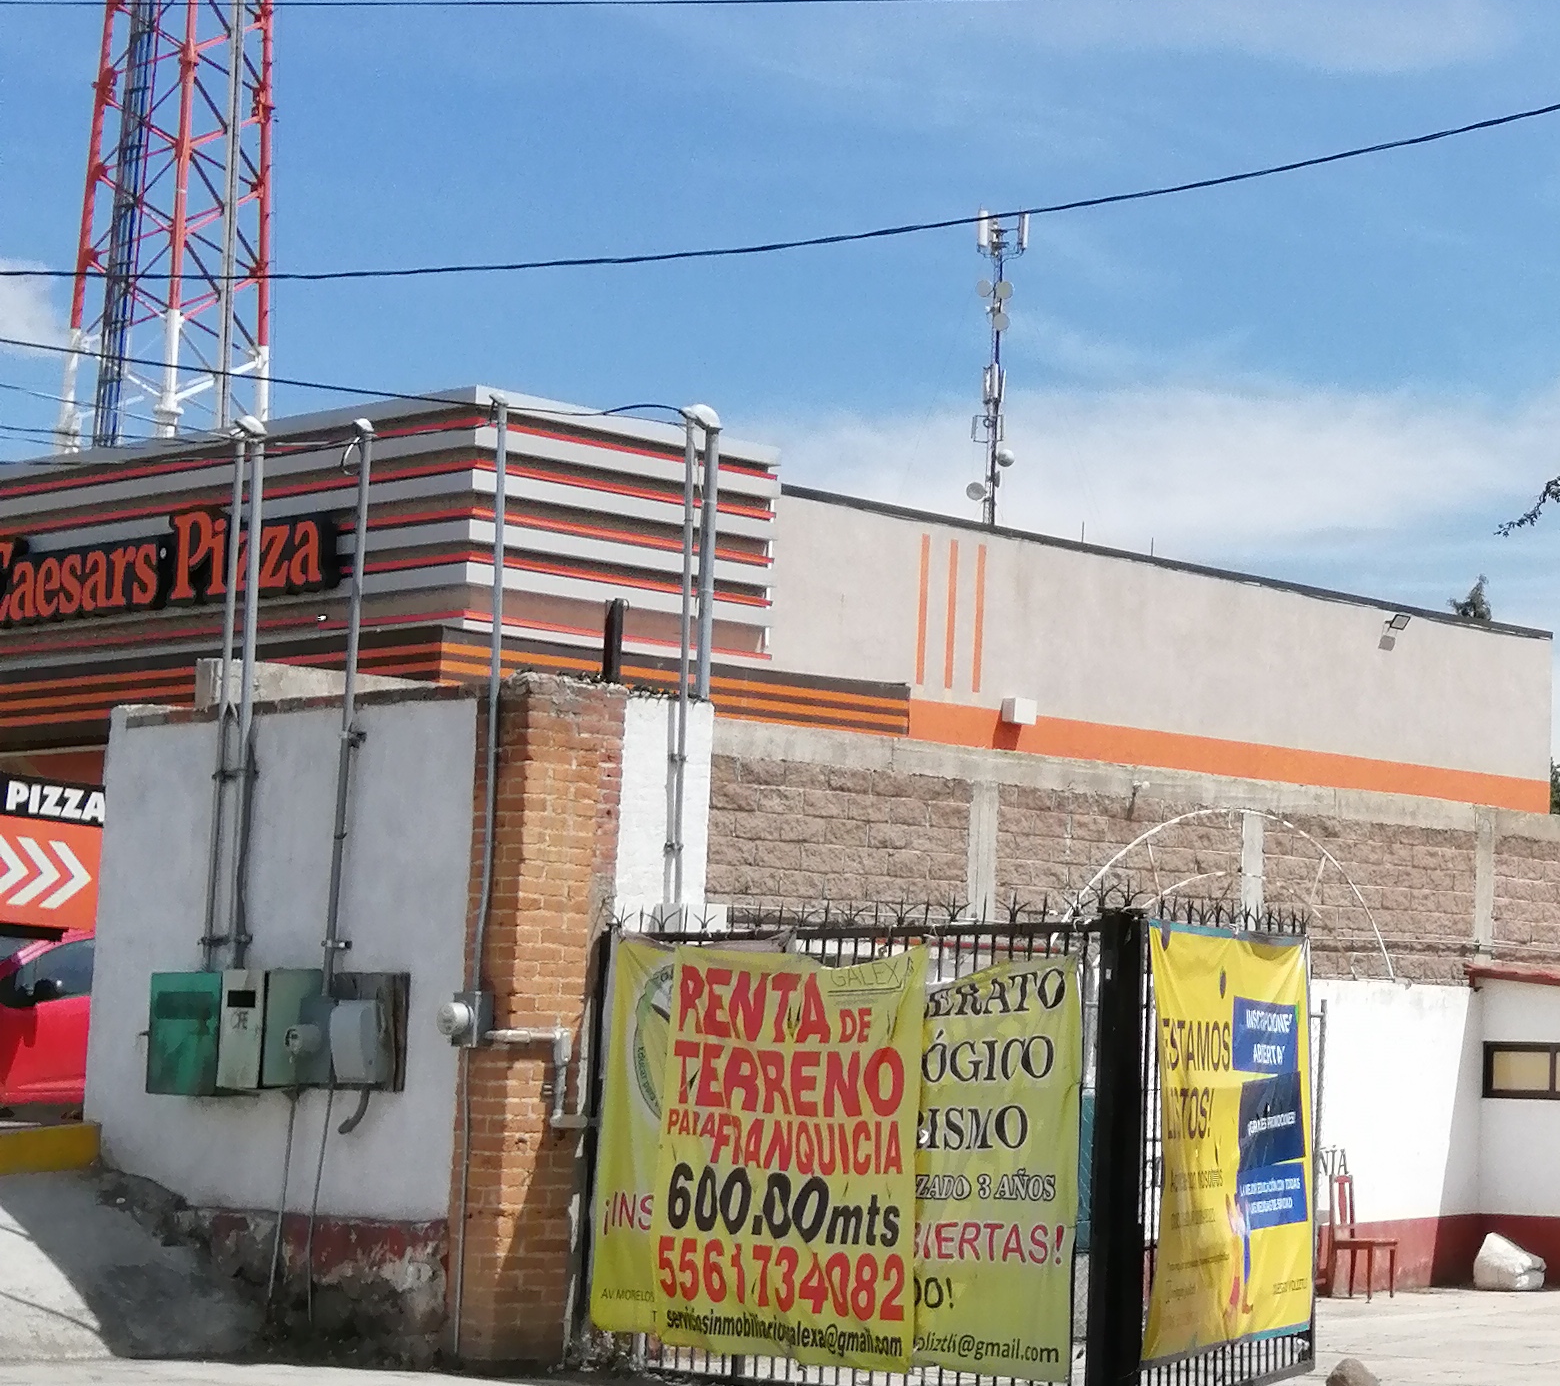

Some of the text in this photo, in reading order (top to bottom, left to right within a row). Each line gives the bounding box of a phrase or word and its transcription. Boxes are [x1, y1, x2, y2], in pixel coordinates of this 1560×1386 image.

[6, 779, 106, 823] PIZZA
[678, 964, 872, 1045] RENTA DE
[923, 967, 1066, 1020] ERATO
[673, 1039, 905, 1118] TERRENO
[709, 1112, 904, 1177] FRANQUICIA
[977, 1173, 992, 1200] 3
[994, 1168, 1056, 1201] AÑOS
